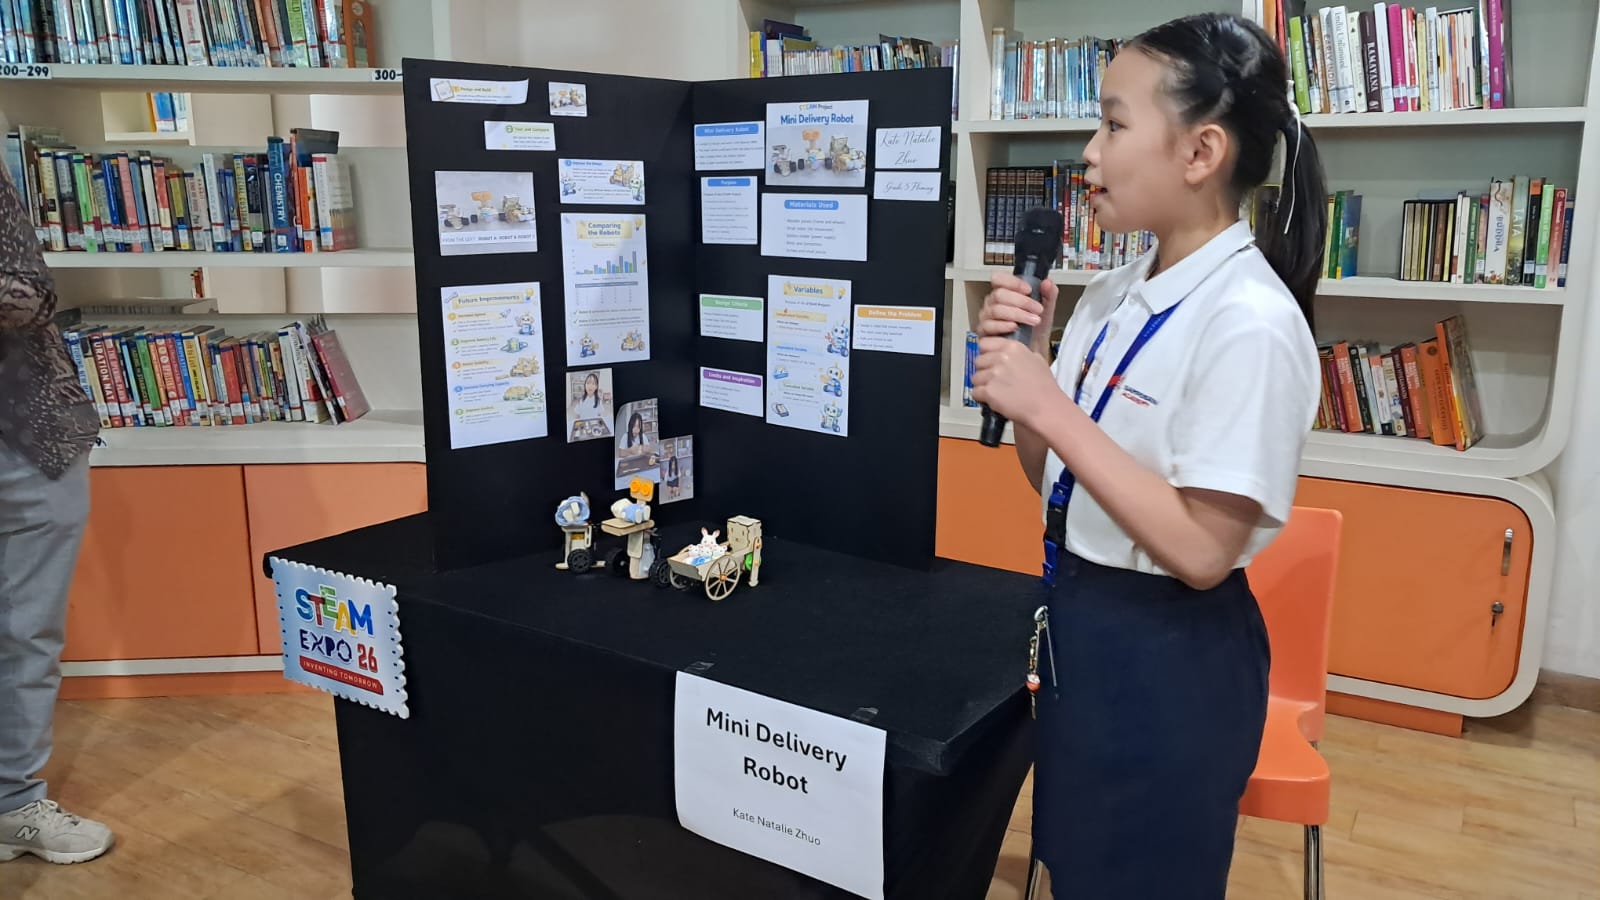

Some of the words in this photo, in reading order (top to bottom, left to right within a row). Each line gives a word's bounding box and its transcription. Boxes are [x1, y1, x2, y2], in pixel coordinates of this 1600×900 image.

[1326, 63, 1336, 88] INDIA
[1364, 41, 1380, 92] RAMAYANA
[780, 115, 797, 124] Mini
[799, 114, 830, 126] Delivery
[831, 113, 854, 124] Robot
[880, 130, 899, 147] Kate
[903, 129, 936, 146] Natalie
[894, 151, 918, 166] Zhuo
[274, 172, 287, 222] CHEMISTRY
[588, 222, 622, 230] Comparing
[1492, 215, 1505, 252] BUDDHA
[1510, 206, 1524, 237] TATA
[794, 284, 823, 294] Variables
[295, 585, 374, 636] STEAM
[299, 629, 353, 662] EXPO
[357, 643, 378, 673] 26
[303, 660, 338, 677] INVENTING
[339, 671, 378, 689] TOMORROW
[706, 707, 750, 738] Mini
[756, 722, 847, 772] Delivery
[743, 756, 809, 794] Robot
[15, 825, 40, 840] N
[732, 807, 755, 824] Kate
[757, 816, 793, 836] Natalie
[795, 828, 821, 846] Zhuo
